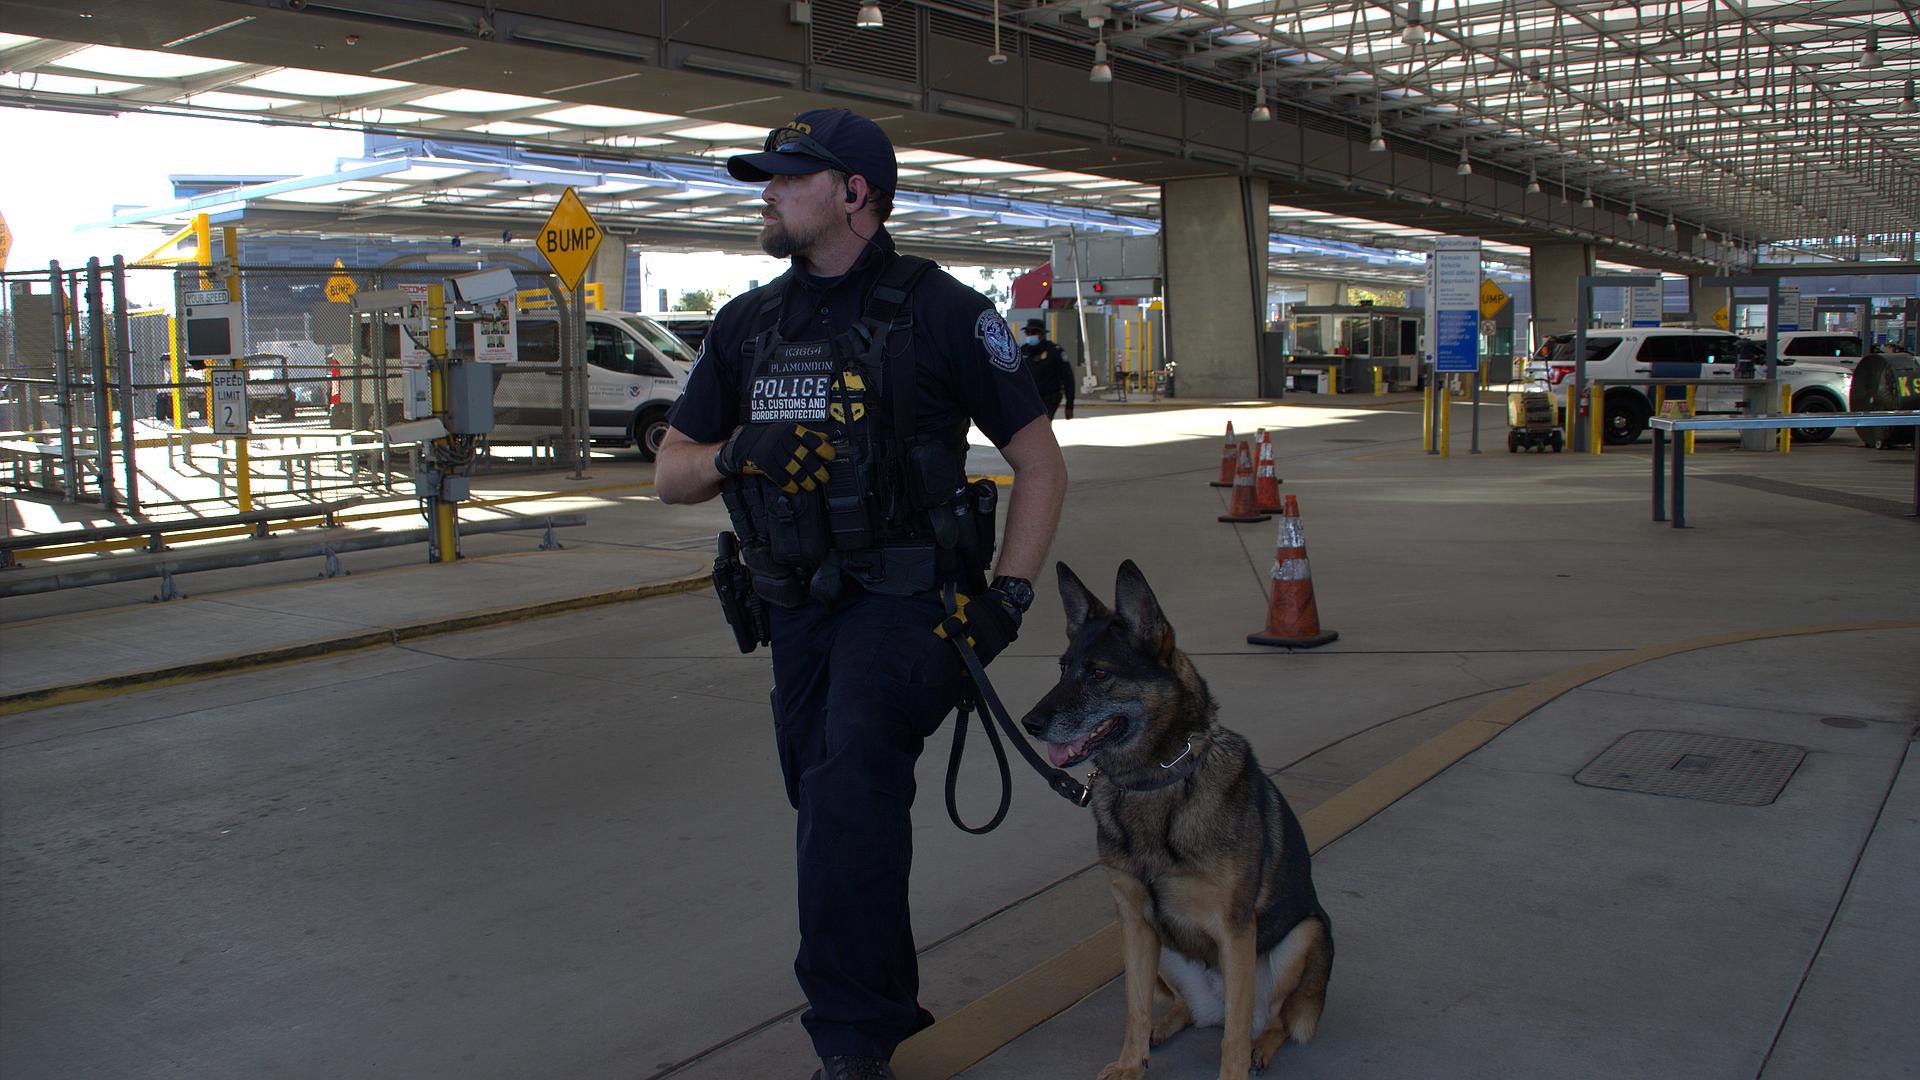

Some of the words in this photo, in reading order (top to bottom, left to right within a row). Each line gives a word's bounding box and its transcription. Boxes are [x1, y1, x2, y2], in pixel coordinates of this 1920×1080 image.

[547, 227, 595, 253] BUMP
[186, 293, 205, 303] YOUR
[207, 292, 227, 302] SPEED
[1481, 295, 1505, 305] UMP
[770, 361, 833, 373] PLAMONDON
[214, 376, 243, 387] SPEED
[753, 377, 828, 398] POLICE
[218, 390, 241, 401] LIMIT
[751, 399, 767, 410] U.S.
[768, 398, 807, 410] CUSTOMS
[808, 398, 826, 409] AND
[223, 406, 235, 426] 2
[751, 410, 779, 420] BORDER
[780, 409, 826, 420] PROTECTION
